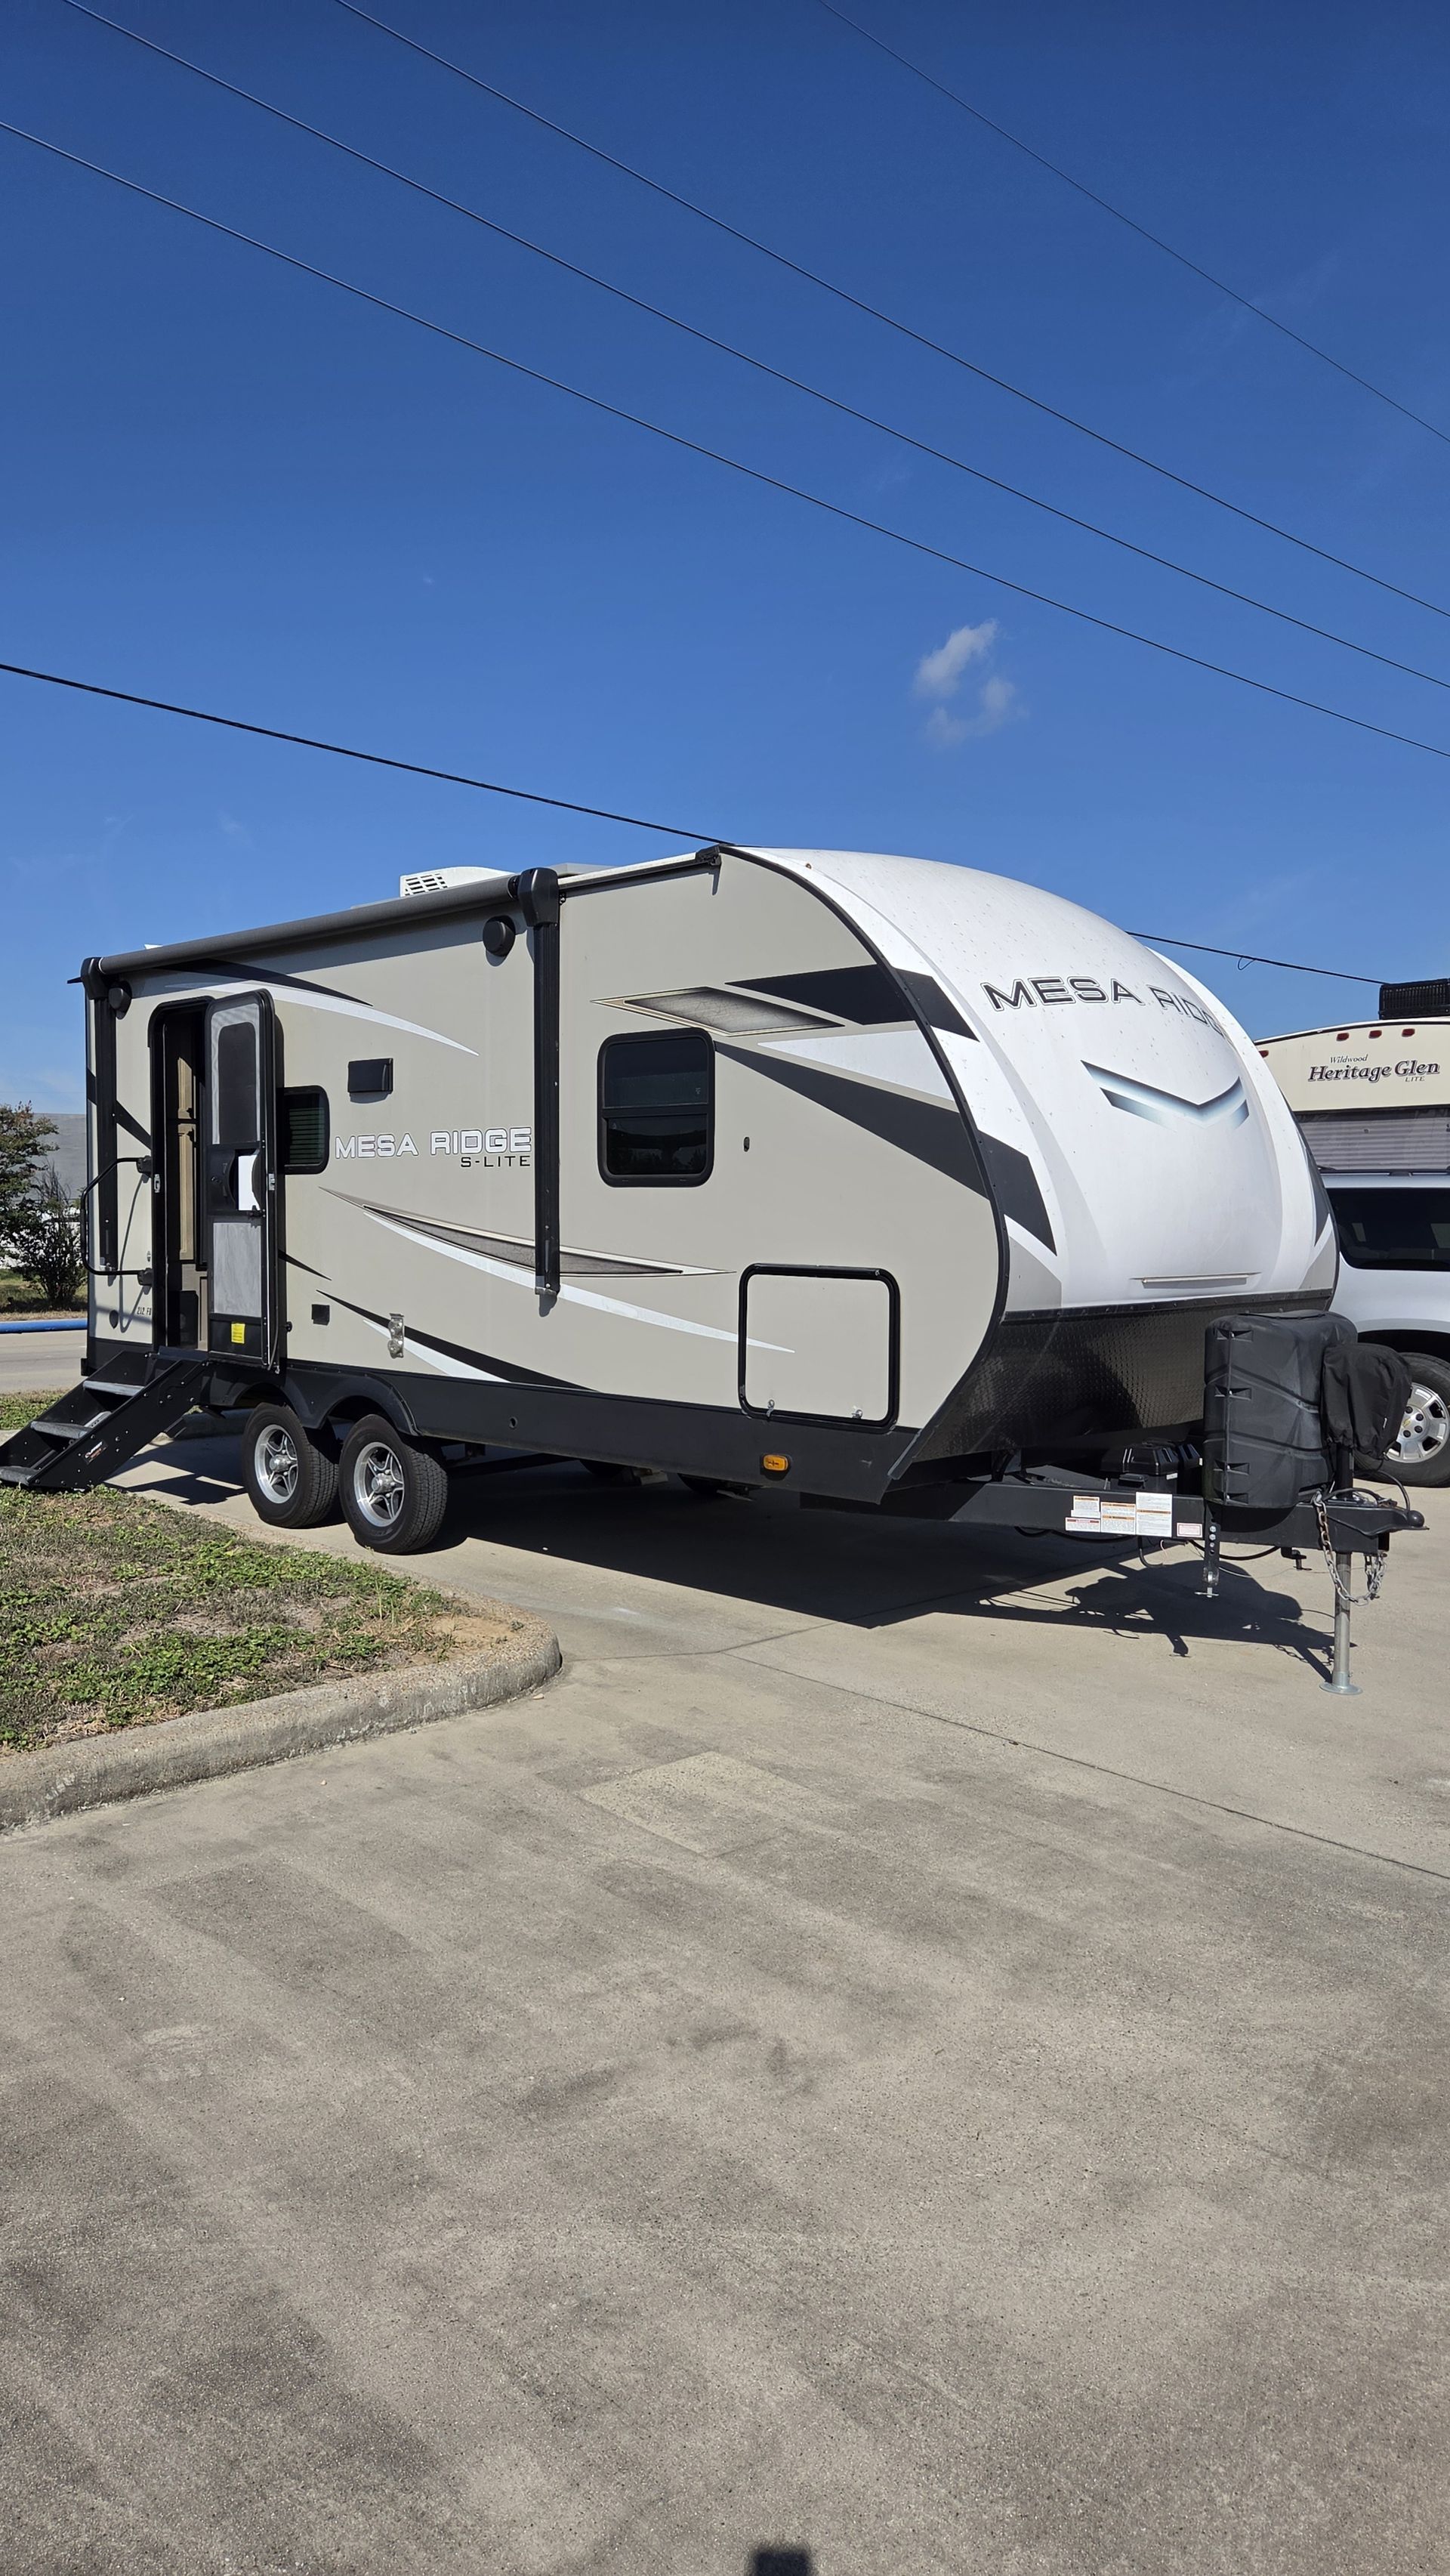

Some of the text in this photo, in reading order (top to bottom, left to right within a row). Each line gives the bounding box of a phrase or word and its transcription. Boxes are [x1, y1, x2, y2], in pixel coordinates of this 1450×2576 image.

[980, 976, 1145, 1012] MESA
[1330, 1054, 1368, 1064] Wildwood
[1308, 1060, 1440, 1083] Heritage Glen
[335, 1126, 532, 1159] MESA RIDGE
[460, 1156, 531, 1167] S-LITE
